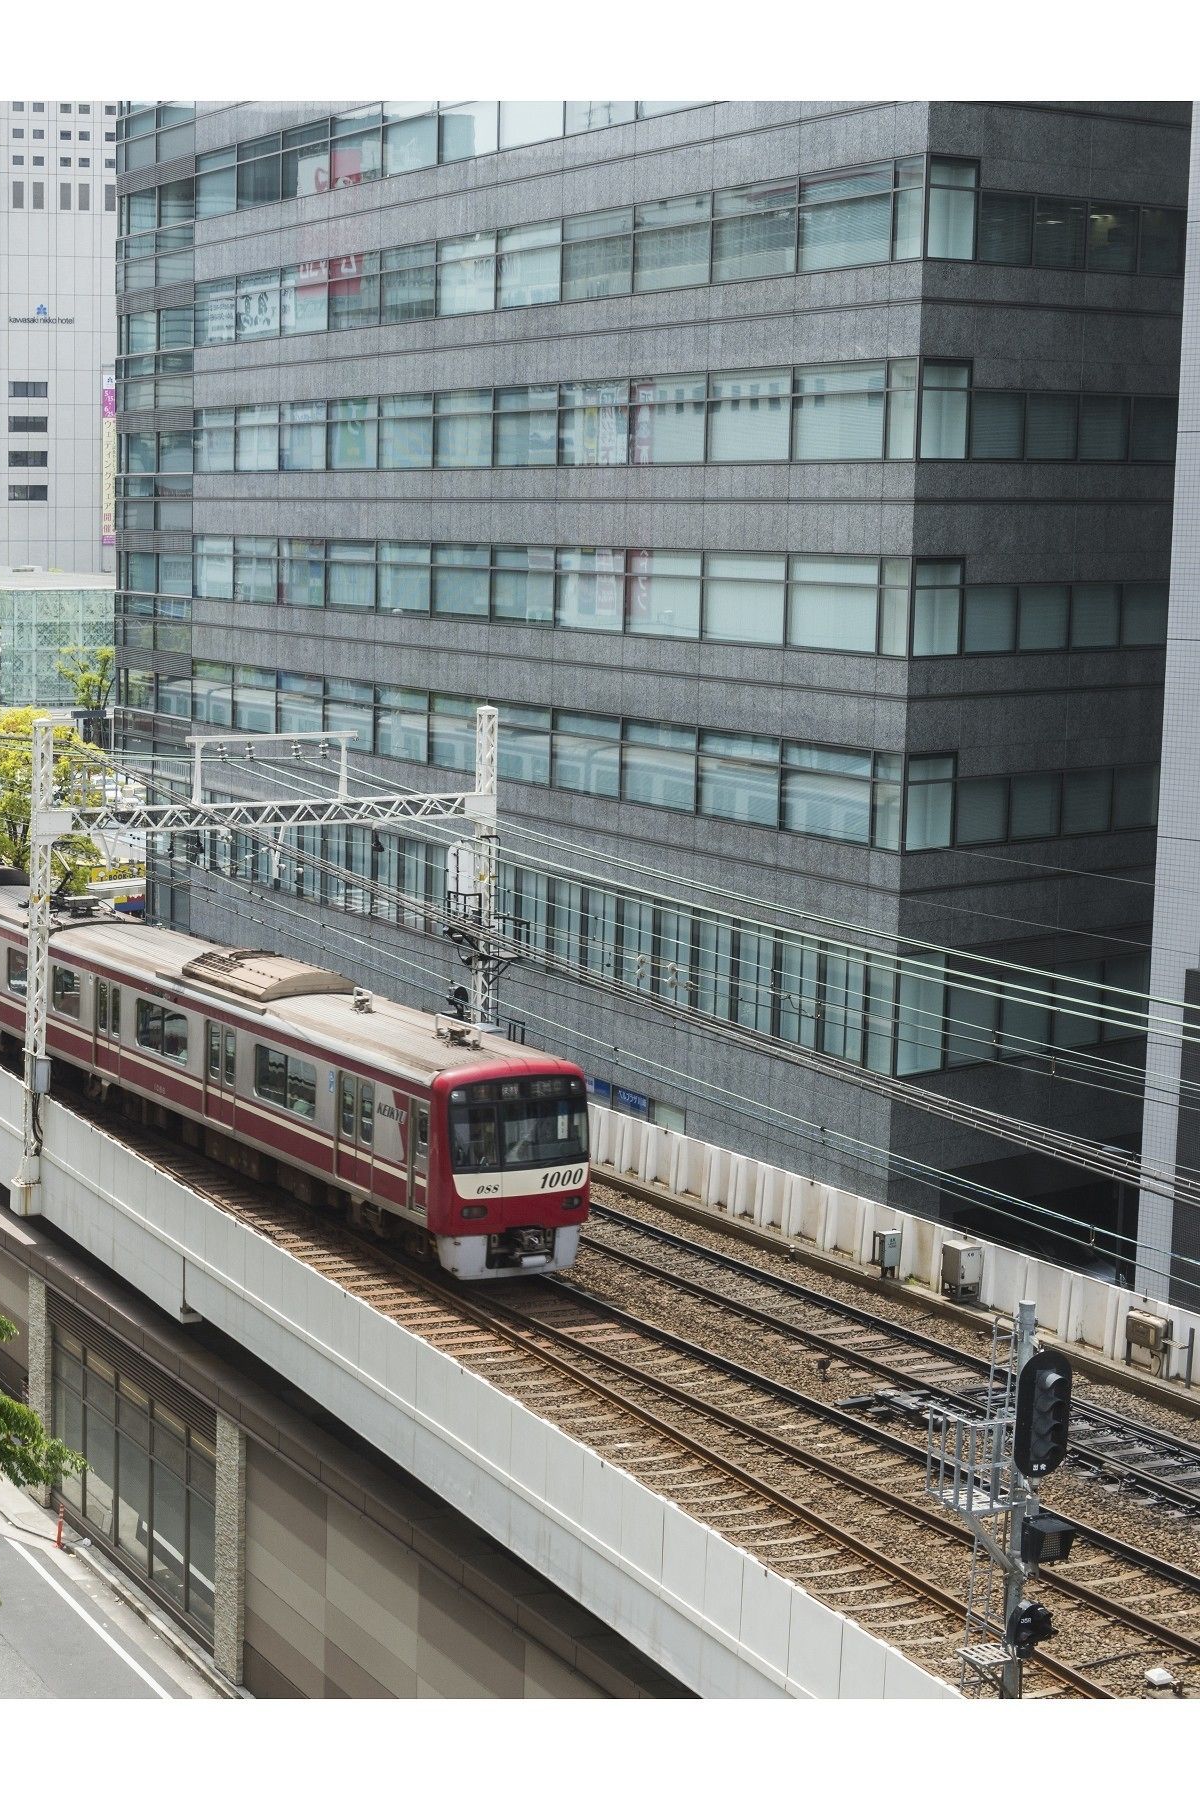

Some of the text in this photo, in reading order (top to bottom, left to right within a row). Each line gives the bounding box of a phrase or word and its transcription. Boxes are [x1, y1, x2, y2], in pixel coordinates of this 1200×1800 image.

[9, 316, 39, 324] kawasaki
[40, 316, 57, 324] nikko
[540, 1168, 583, 1189] 1000
[476, 1184, 499, 1195] 088
